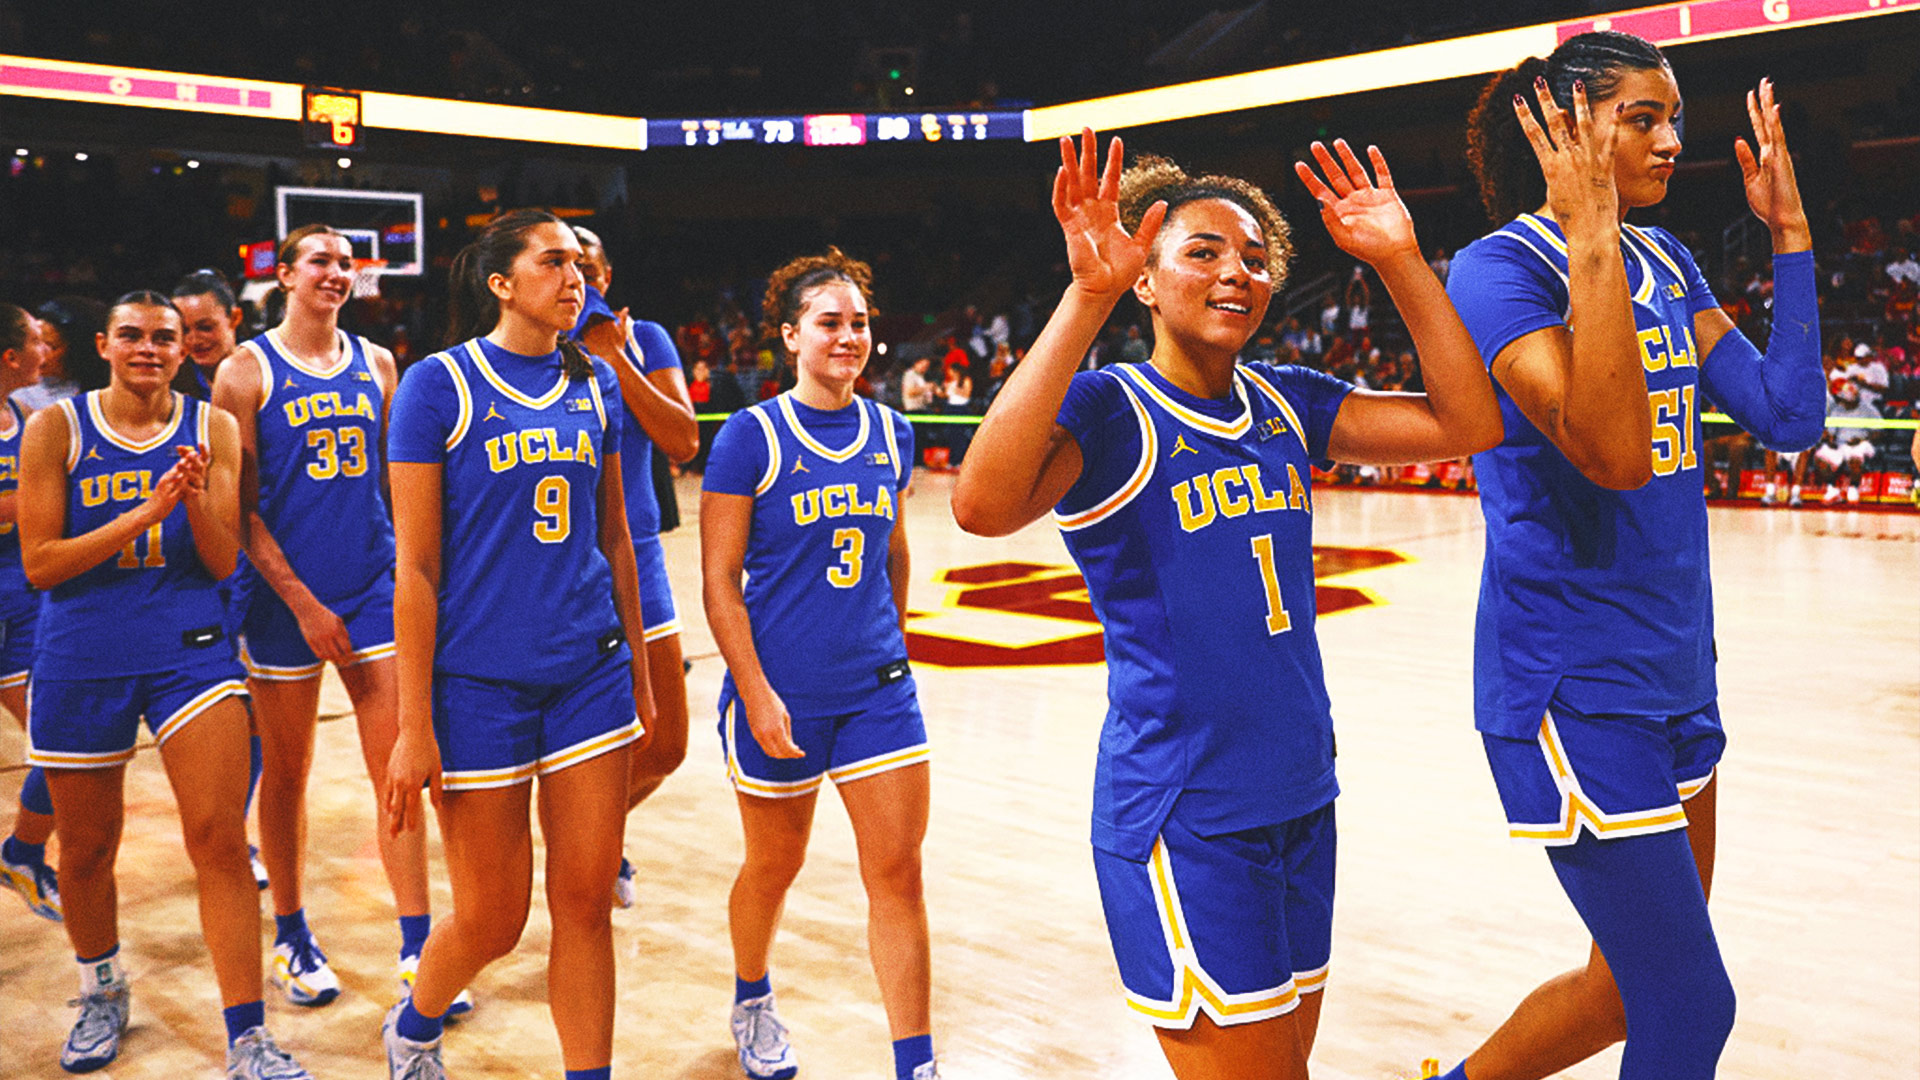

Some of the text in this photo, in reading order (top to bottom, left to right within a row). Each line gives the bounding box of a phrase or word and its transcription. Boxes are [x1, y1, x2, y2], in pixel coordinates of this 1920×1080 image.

[284, 392, 375, 427] UCLA
[1649, 384, 1697, 476] 51
[307, 427, 368, 480] 33
[485, 428, 597, 473] UCLA
[80, 469, 153, 507] UCL
[533, 475, 570, 543] 9
[791, 484, 894, 525] UCLA
[1171, 464, 1311, 533] UCLA
[826, 528, 864, 588] 3
[1250, 534, 1292, 636] 1
